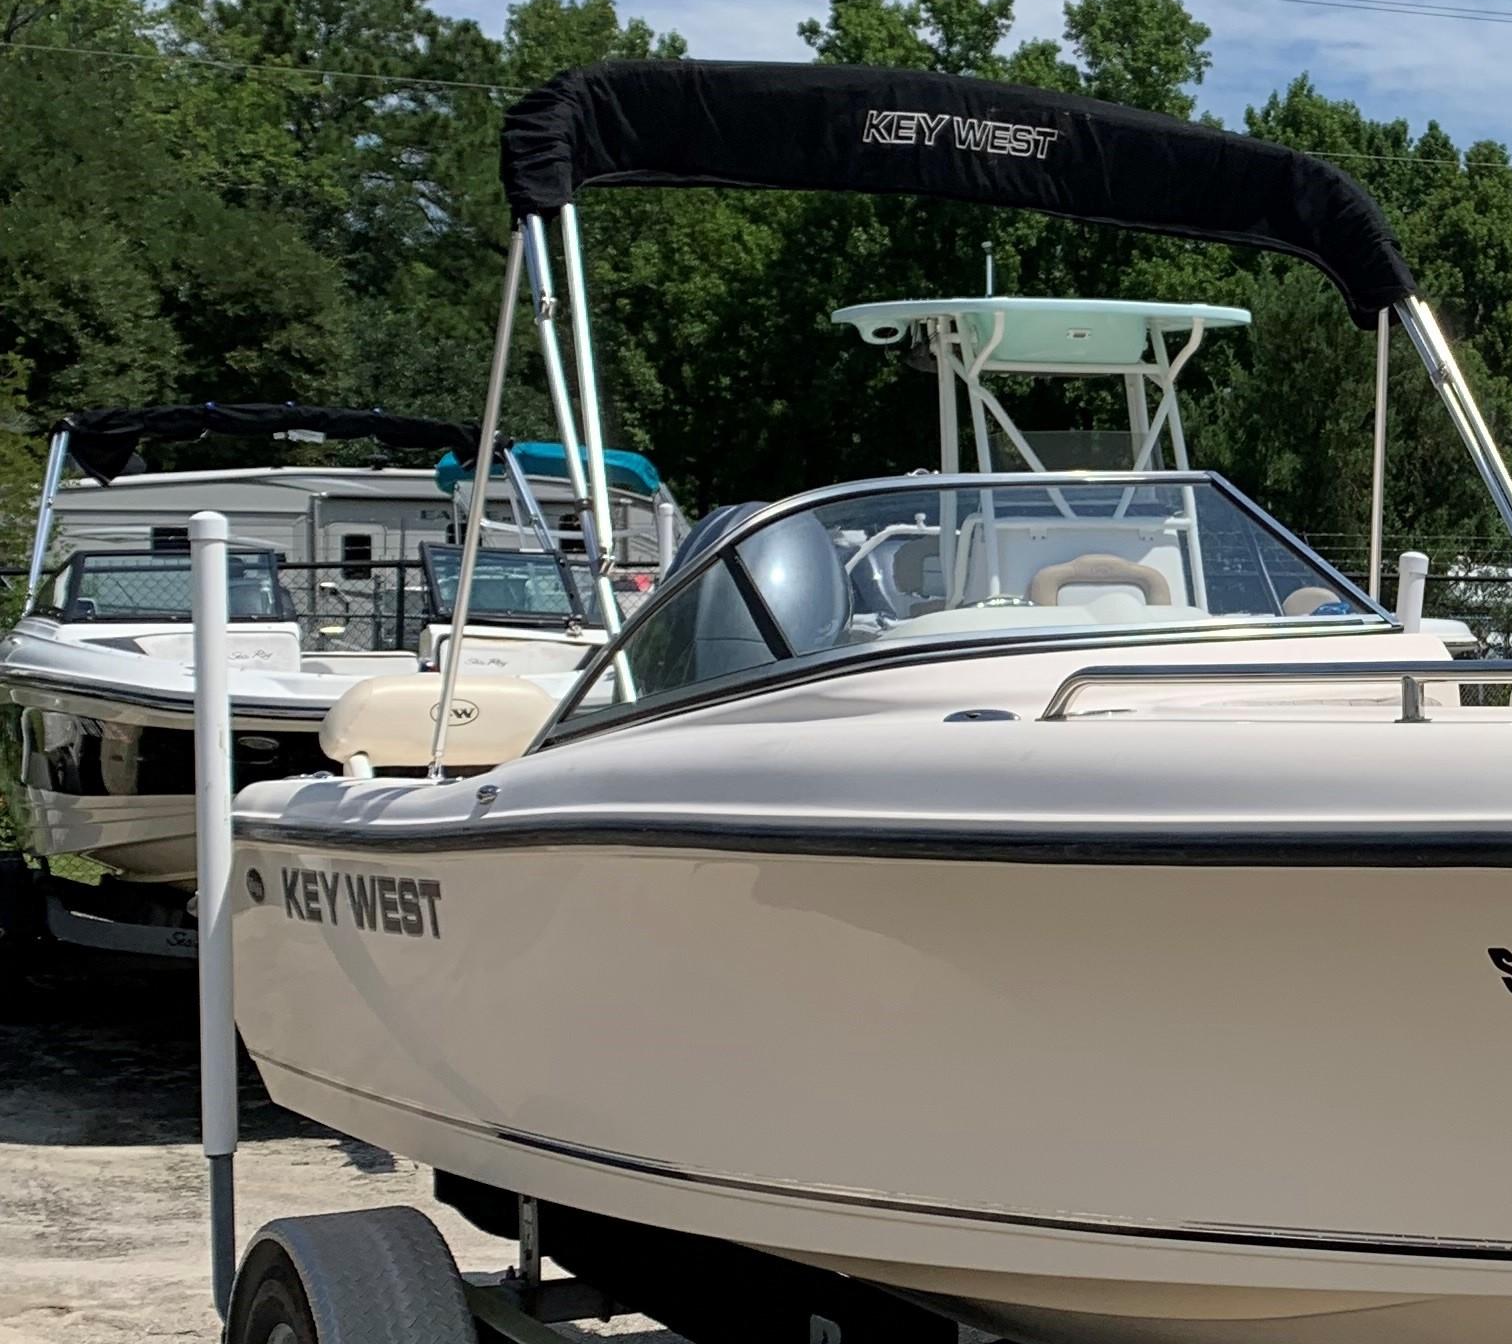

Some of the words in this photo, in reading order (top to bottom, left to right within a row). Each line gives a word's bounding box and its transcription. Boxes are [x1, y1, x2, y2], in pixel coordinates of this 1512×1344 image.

[863, 110, 950, 145] KEY
[953, 116, 1058, 159] WEST
[281, 867, 339, 926] KEY
[345, 873, 442, 939] WEST
